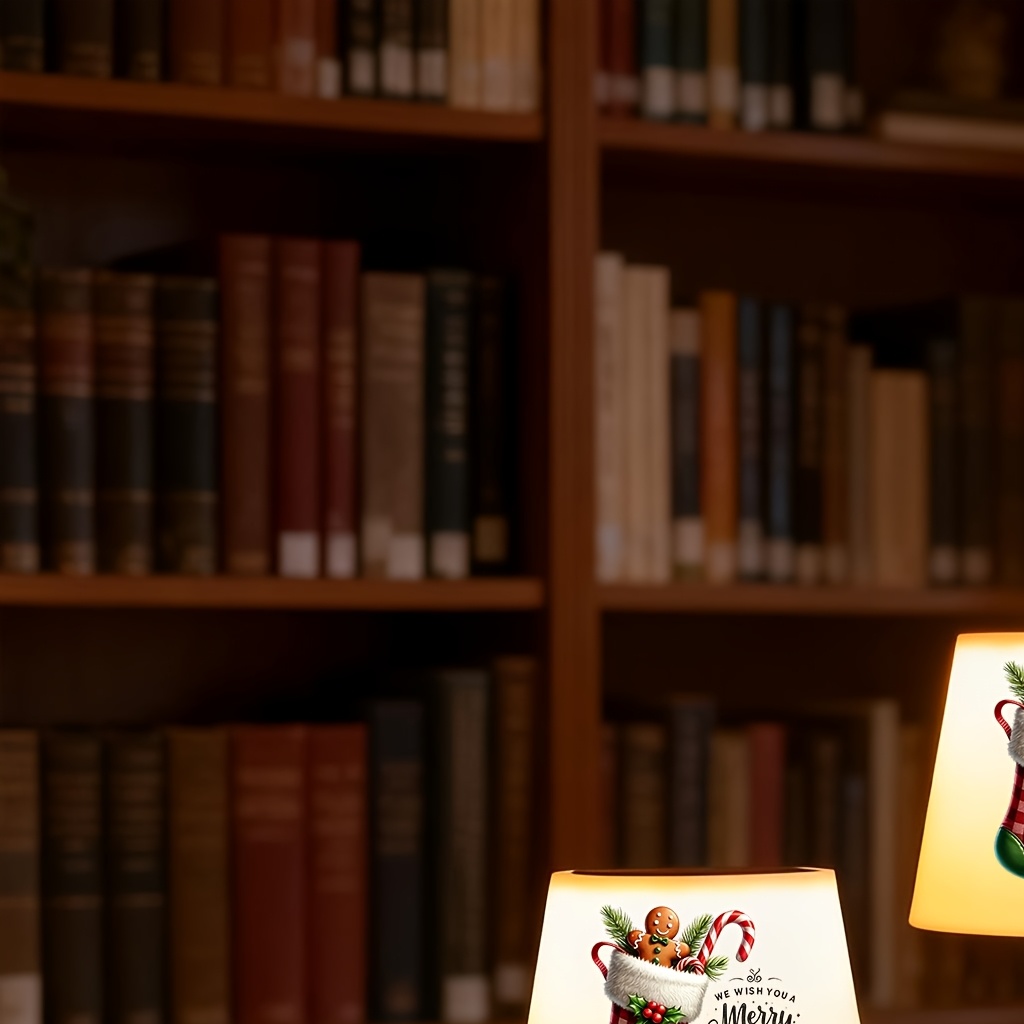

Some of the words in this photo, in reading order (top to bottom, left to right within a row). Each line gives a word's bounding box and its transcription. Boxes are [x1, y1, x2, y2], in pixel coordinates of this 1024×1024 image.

[714, 990, 730, 1001] WE
[733, 986, 763, 996] WISH
[766, 987, 788, 1000] YOU
[789, 995, 796, 1003] A
